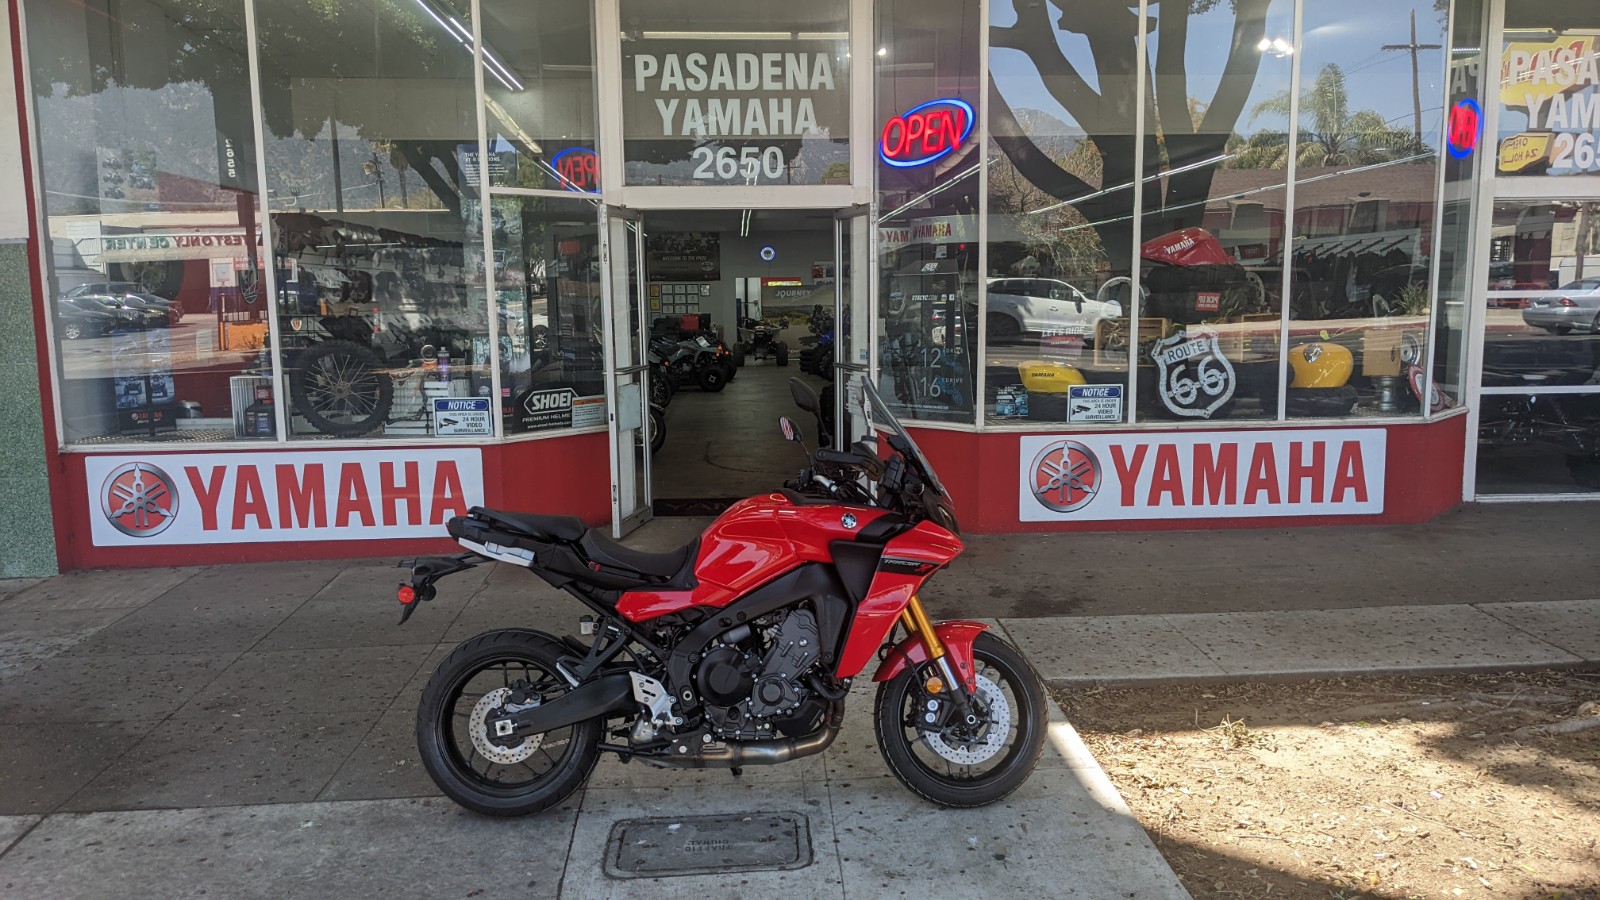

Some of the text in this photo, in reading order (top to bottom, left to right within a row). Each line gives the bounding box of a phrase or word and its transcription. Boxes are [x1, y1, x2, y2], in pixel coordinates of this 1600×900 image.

[634, 52, 835, 92] PASADENA
[1510, 49, 1599, 86] PASA
[654, 97, 820, 136] YAMAHA
[1525, 93, 1600, 129] YAM
[882, 108, 965, 158] OPEN
[692, 146, 785, 179] 2650
[1552, 132, 1600, 169] 26
[917, 223, 952, 238] YAMAHA
[1165, 237, 1195, 255] YAMAHA
[775, 289, 812, 298] JOURNEY
[920, 347, 941, 368] 12
[1167, 340, 1206, 362] ROUTE
[920, 376, 941, 397] 16
[1082, 388, 1110, 397] NOTICE
[1170, 355, 1225, 405] 66
[447, 401, 476, 410] NOTICE
[531, 391, 572, 411] SHOEI
[522, 415, 550, 423] PREMIUM
[1108, 440, 1369, 507] YAMAHA
[183, 460, 469, 531] YAMAHA
